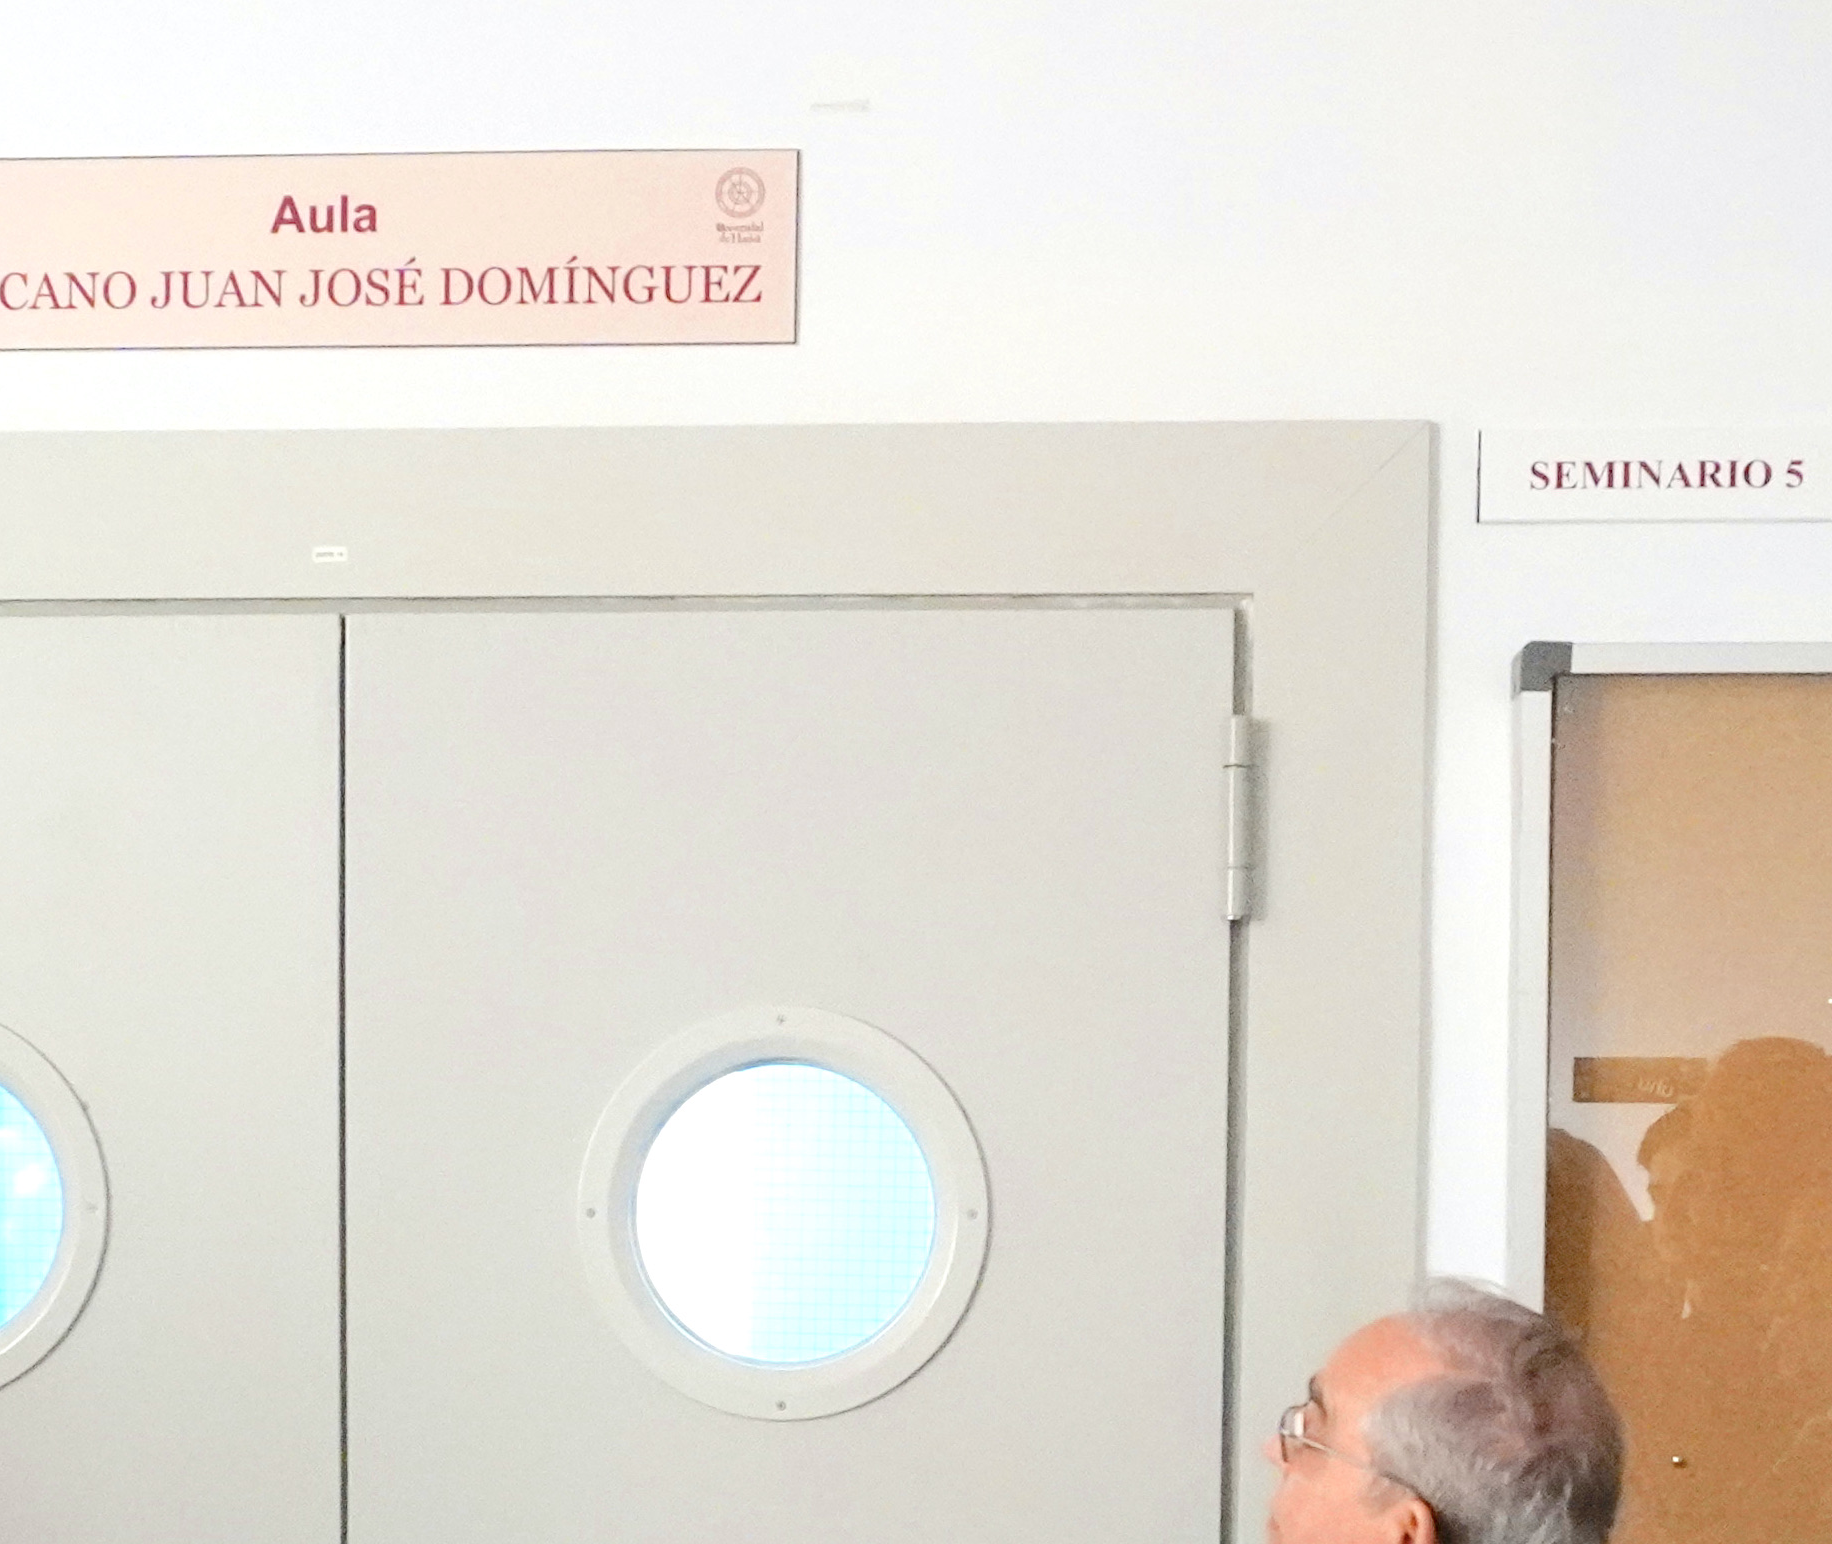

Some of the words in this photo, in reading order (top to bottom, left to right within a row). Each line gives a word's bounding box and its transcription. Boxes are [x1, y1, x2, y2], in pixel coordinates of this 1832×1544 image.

[270, 195, 378, 235] Aula
[151, 271, 287, 310] JUAN
[299, 257, 425, 308] JOSÉ
[441, 257, 764, 307] DOMÍNGUEZ
[1529, 459, 1773, 491] SEMINARIO
[1786, 459, 1805, 489] 5
